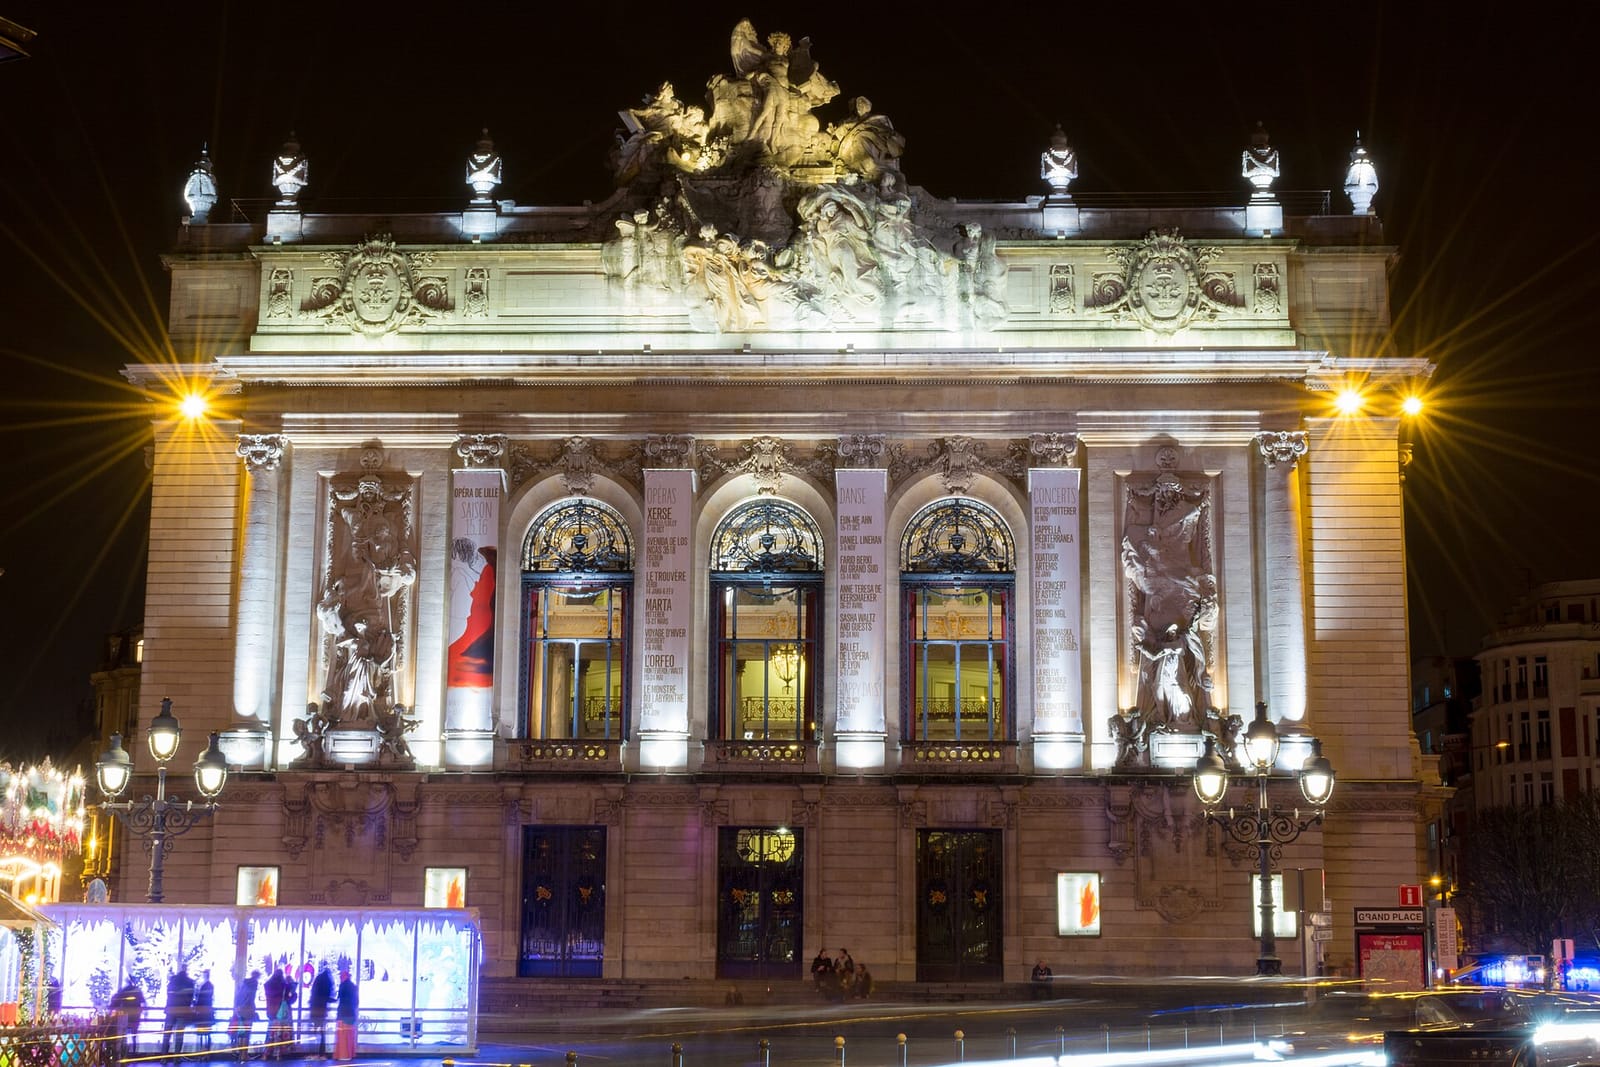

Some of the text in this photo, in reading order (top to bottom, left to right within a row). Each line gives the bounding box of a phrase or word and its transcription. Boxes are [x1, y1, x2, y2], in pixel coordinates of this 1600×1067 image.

[475, 487, 483, 498] DE
[483, 487, 499, 498] LILLE
[840, 487, 867, 504] DANSE
[1033, 487, 1077, 504] CONCERTS
[461, 501, 493, 519] SAISON
[647, 507, 673, 520] XERSE
[861, 515, 873, 524] AHN
[1034, 525, 1062, 534] CAPPELLA
[646, 536, 689, 546] AVENIDA DE LOS
[840, 535, 882, 545] DANIEL LINEHAN
[848, 564, 866, 573] GRAND
[645, 572, 654, 582] LE
[840, 584, 882, 593] ANNE TERESA DE
[1035, 581, 1067, 590] LE CONCERT
[645, 598, 673, 611] MARTA
[840, 613, 876, 622] SASHA WALTZ
[840, 622, 873, 632] AND GUESTS
[644, 628, 664, 638] VOYAGE
[840, 642, 859, 652] BALLET
[644, 654, 675, 668] L'ORFEO
[840, 652, 847, 661] DE
[840, 661, 861, 670] DE LYON
[1358, 912, 1422, 921] GRAND PLACE
